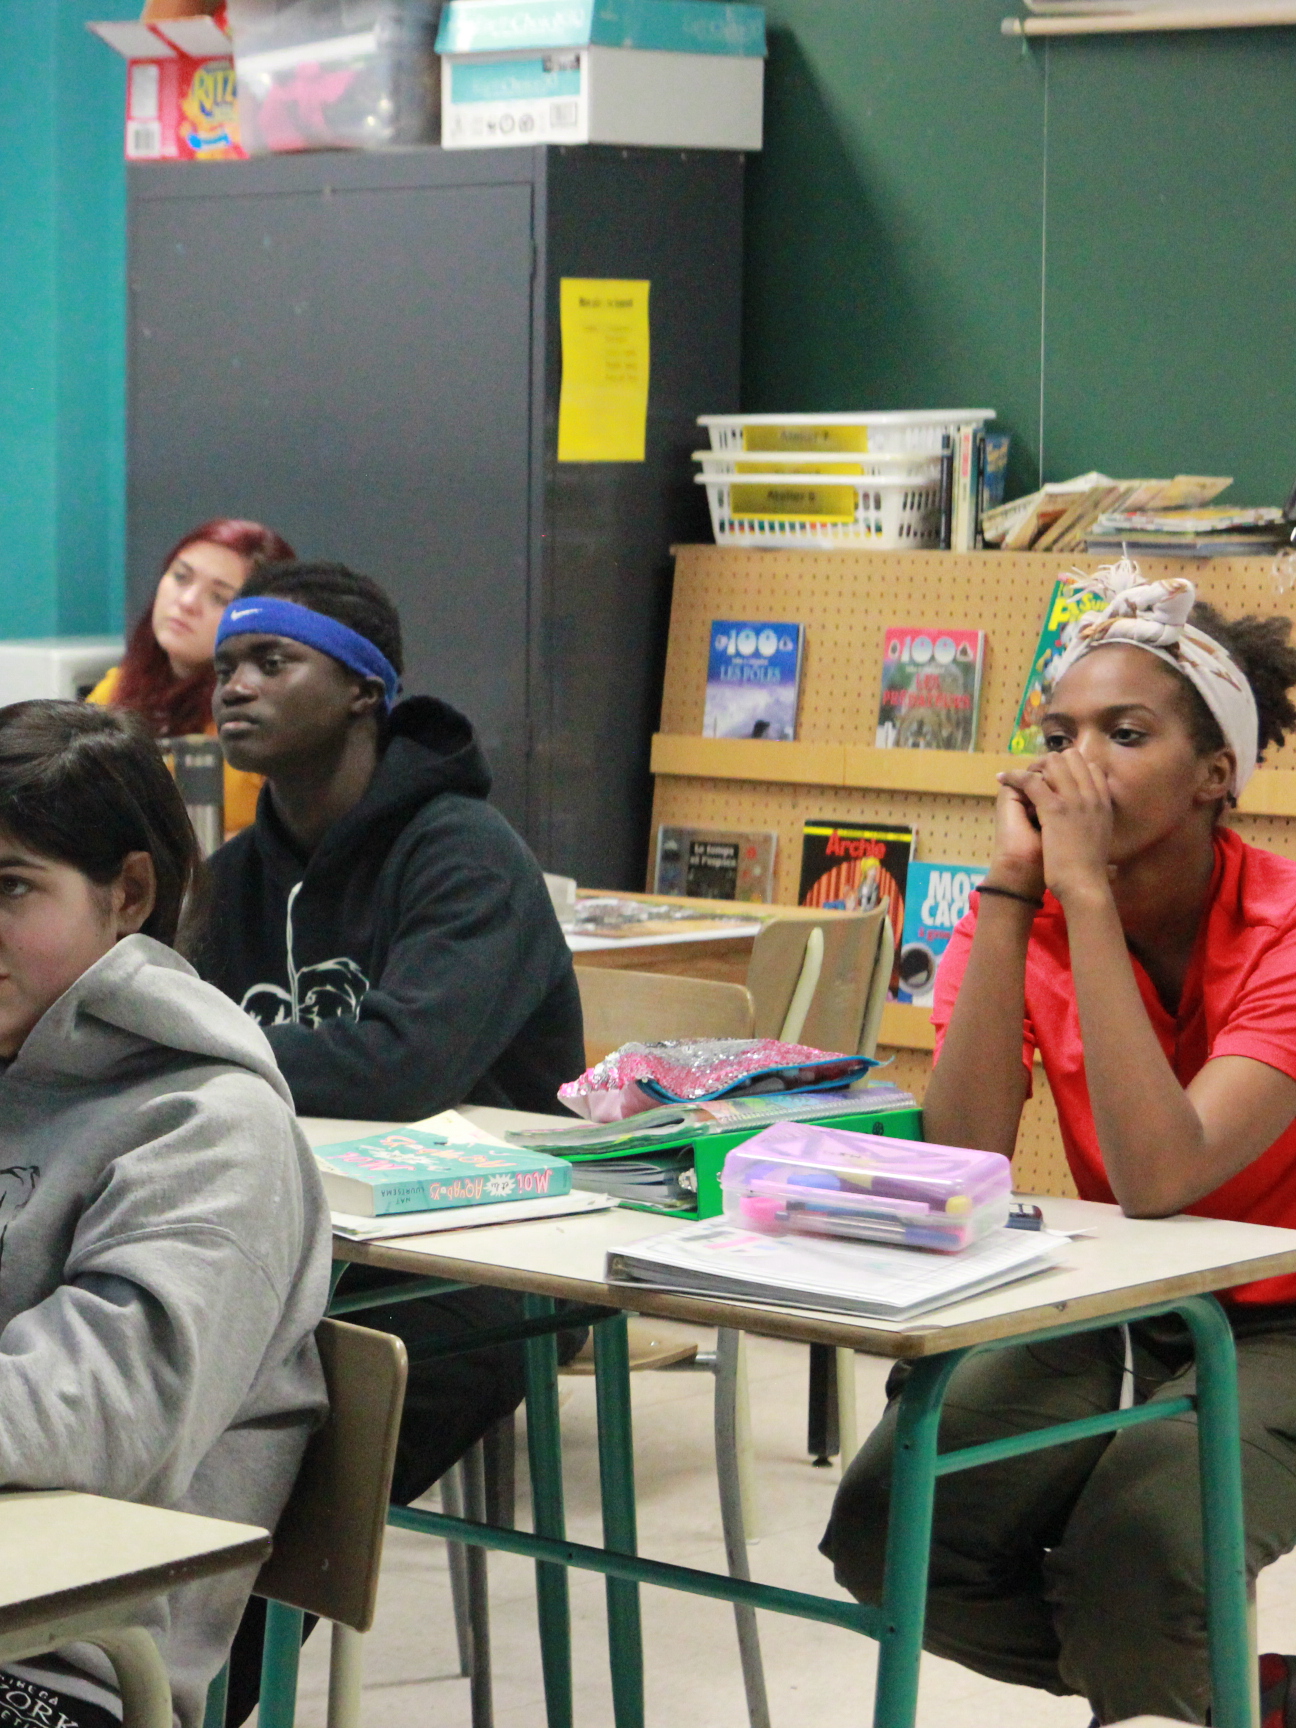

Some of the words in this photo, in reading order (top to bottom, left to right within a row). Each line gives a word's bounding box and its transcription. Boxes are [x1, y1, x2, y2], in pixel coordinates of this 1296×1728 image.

[726, 628, 778, 657] 100
[900, 636, 956, 665] 100
[825, 829, 887, 859] Archie
[516, 1169, 553, 1194] Moi
